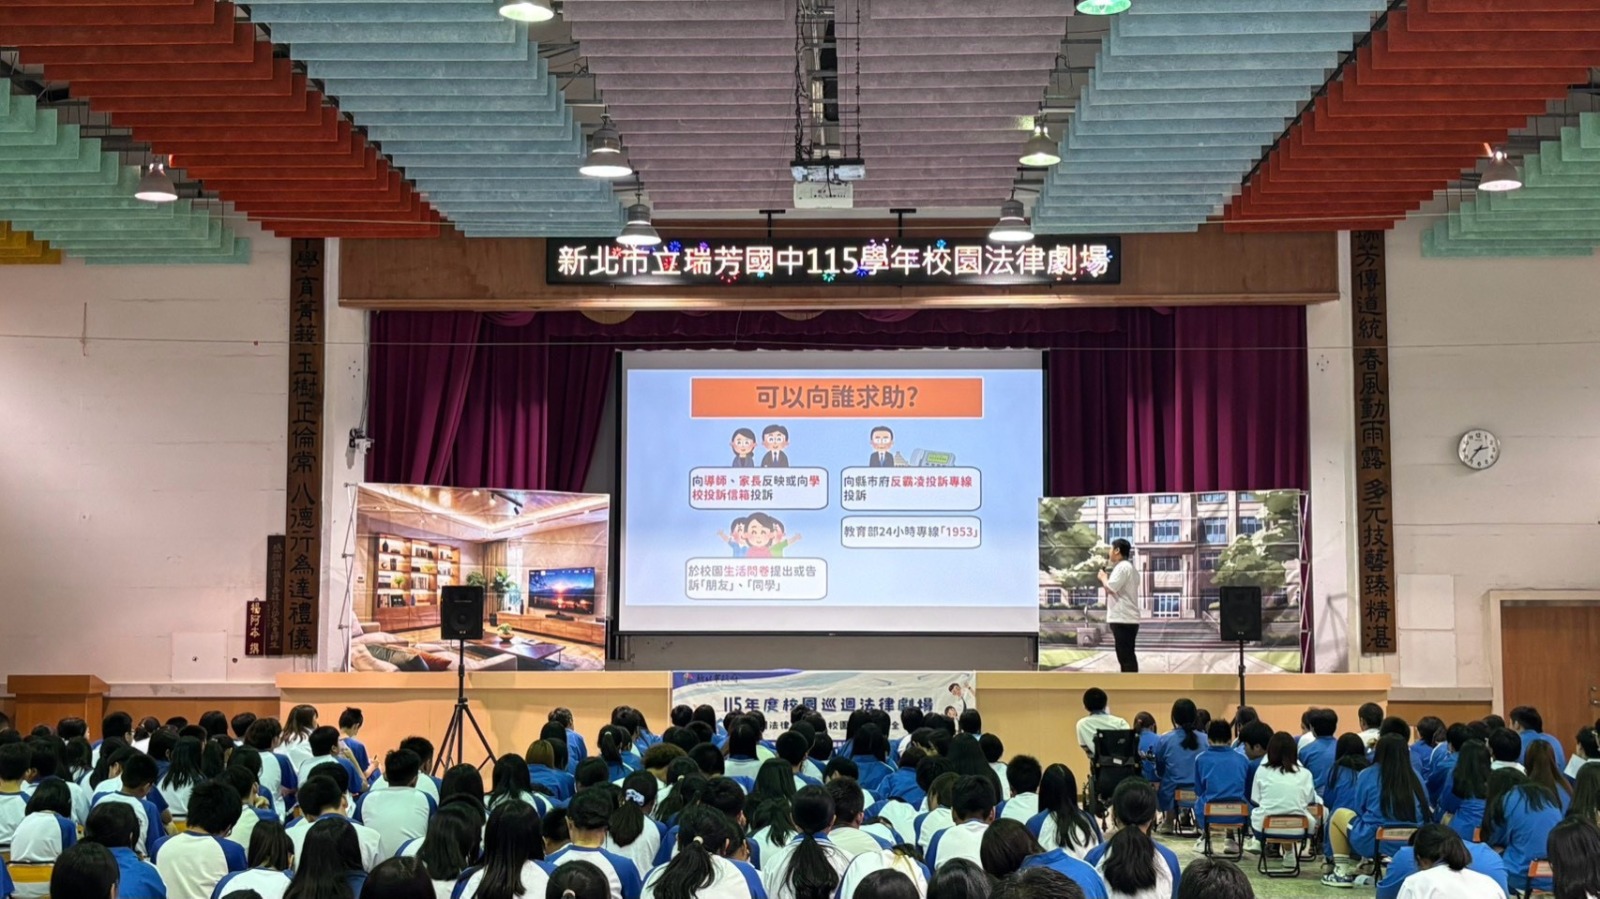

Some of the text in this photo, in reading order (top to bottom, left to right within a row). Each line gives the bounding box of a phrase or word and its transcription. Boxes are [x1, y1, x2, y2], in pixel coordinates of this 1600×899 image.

[557, 244, 1109, 277] 新北市立瑞芳國中115學年校園法律劇場
[756, 385, 918, 410] 可以向誰求助?
[692, 474, 820, 487] 向導師、家長反映或向學
[843, 475, 973, 488] 向縣市府反霸凌投訴專線
[692, 488, 774, 501] 校投訴信箱投訴
[843, 489, 867, 502] 投訴
[688, 565, 817, 577] 於校園生活問卷提出或告
[724, 697, 934, 712] 115年度校園巡迴法律劇場
